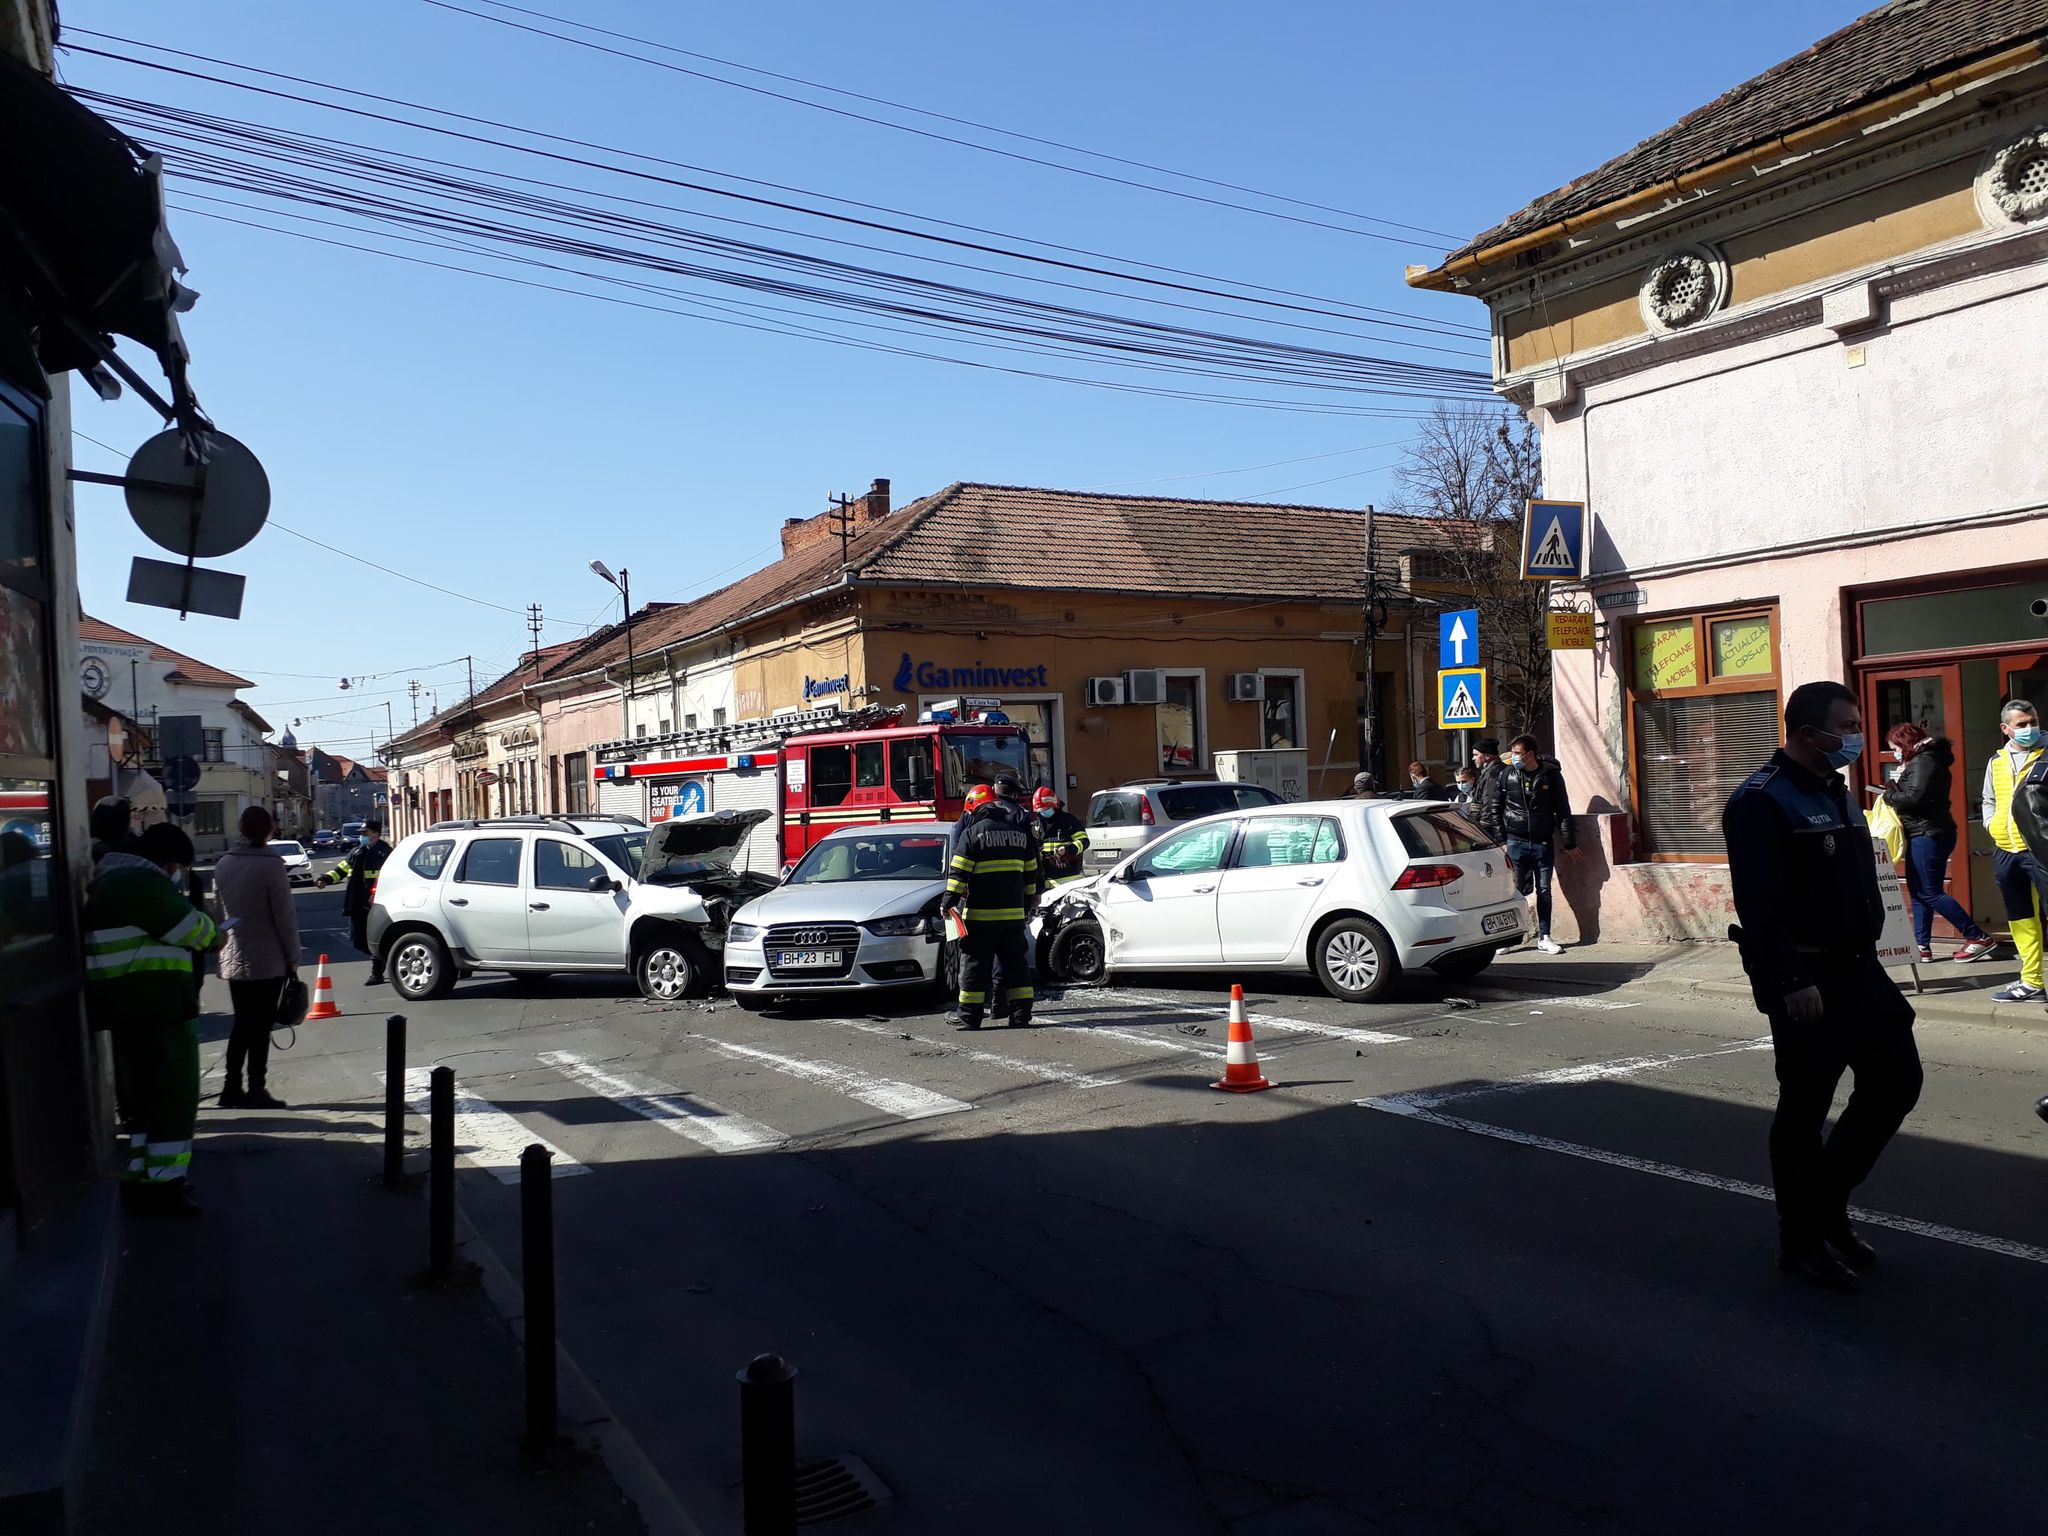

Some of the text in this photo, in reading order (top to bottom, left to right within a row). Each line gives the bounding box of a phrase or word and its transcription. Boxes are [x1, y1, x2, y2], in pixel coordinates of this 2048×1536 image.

[1552, 626, 1591, 635] TELEFOANE
[1561, 638, 1586, 646] MOBILE
[916, 660, 1048, 688] Gaminvest
[809, 673, 849, 698] Gaminvest
[651, 785, 679, 796] IS YOUR
[789, 784, 803, 793] 112
[651, 795, 685, 807] SEATBELT
[651, 807, 666, 817] ON?
[783, 953, 801, 965] BH
[803, 951, 817, 964] 23
